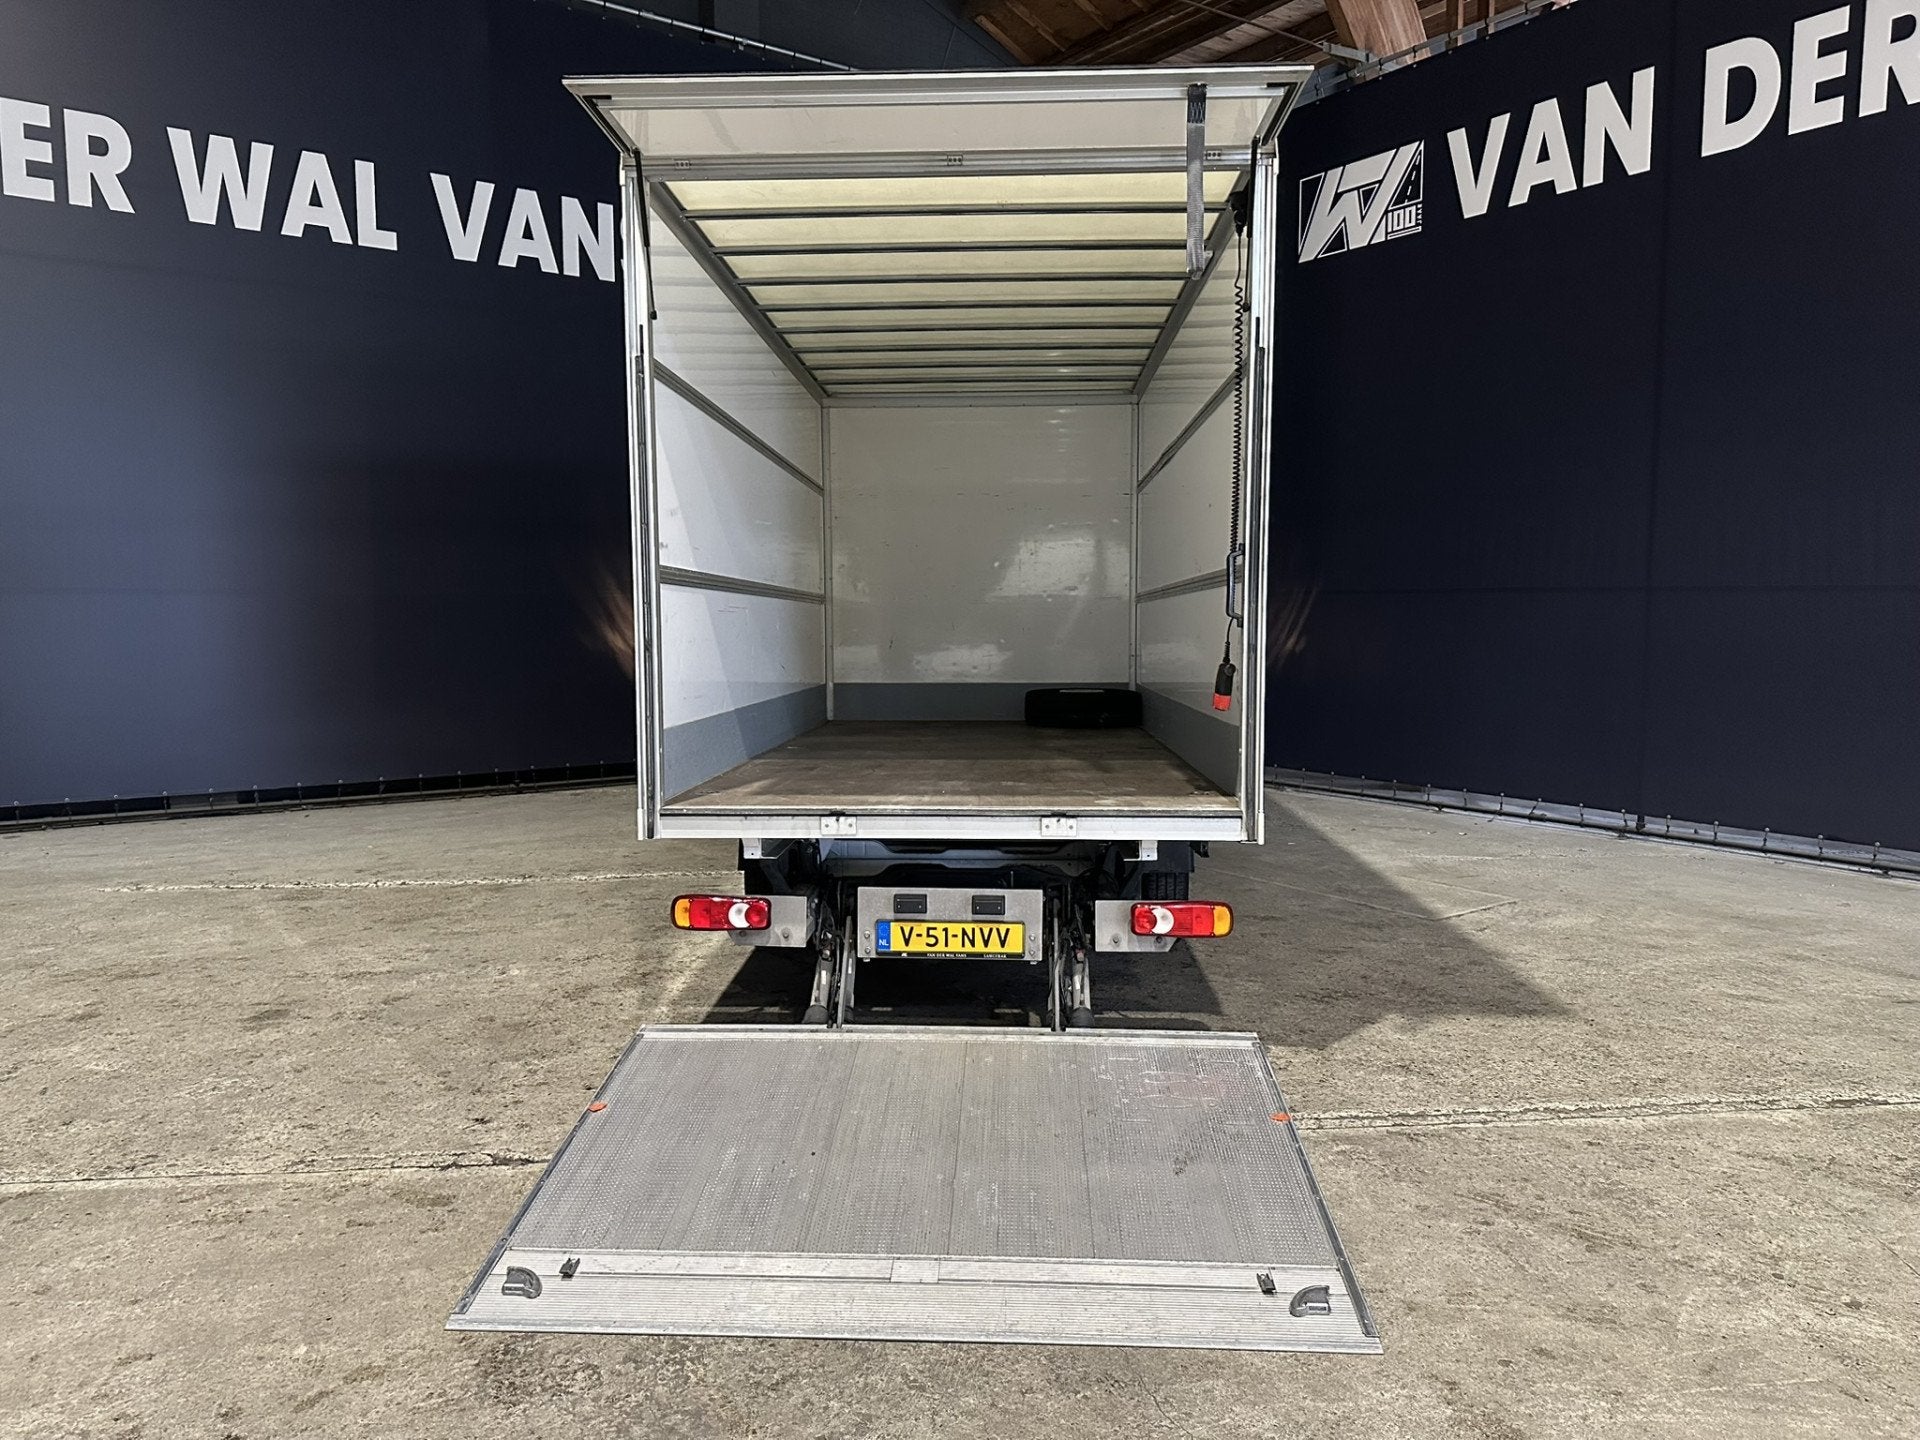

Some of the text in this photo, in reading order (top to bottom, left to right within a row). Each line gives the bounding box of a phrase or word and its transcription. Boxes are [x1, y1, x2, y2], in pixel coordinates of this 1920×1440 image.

[1447, 0, 1920, 219] VAN DER
[0, 97, 624, 283] ER WAL VAN
[1387, 205, 1416, 233] 100
[878, 938, 889, 946] NL
[899, 926, 1011, 948] V-51-NVV
